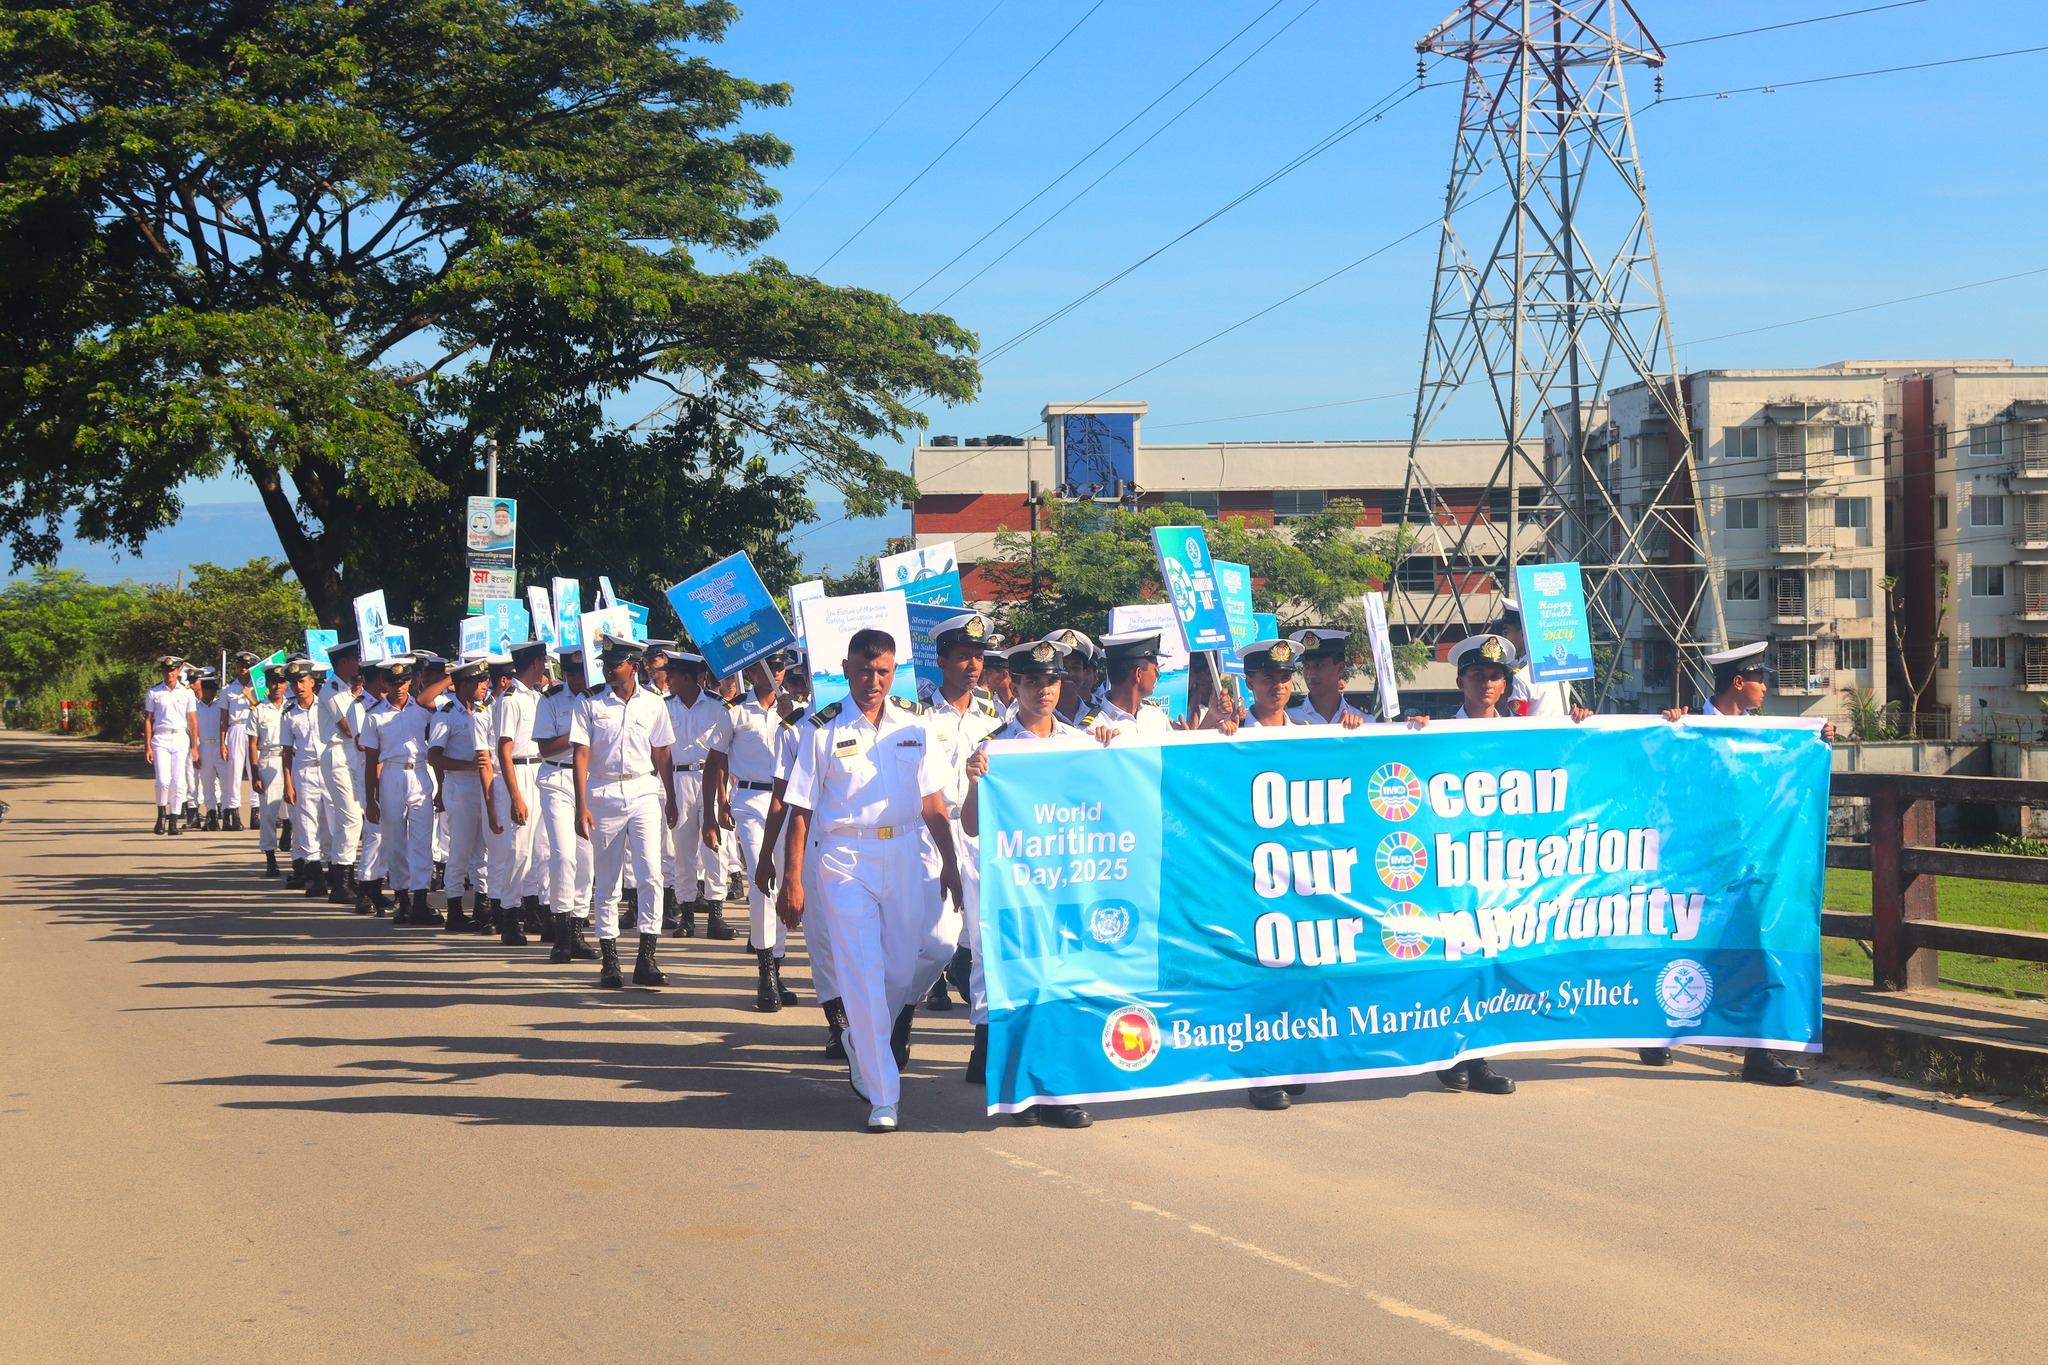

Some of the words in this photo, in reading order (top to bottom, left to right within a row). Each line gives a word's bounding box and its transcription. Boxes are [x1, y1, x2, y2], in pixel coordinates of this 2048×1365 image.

[472, 569, 490, 583] মা
[499, 604, 507, 613] 26
[1537, 600, 1572, 611] Happy
[1540, 608, 1571, 618] World
[1537, 619, 1579, 628] Maritime
[1543, 629, 1575, 642] DAY
[1252, 771, 1352, 829] Our
[1034, 801, 1103, 825] World
[996, 825, 1136, 860] Maritime
[1252, 842, 1358, 899] Our
[1254, 912, 1364, 968] Our
[1171, 1007, 1339, 1052] Bangladesh
[1347, 1001, 1450, 1036] Marine
[1557, 978, 1640, 1015] Sylhet.
